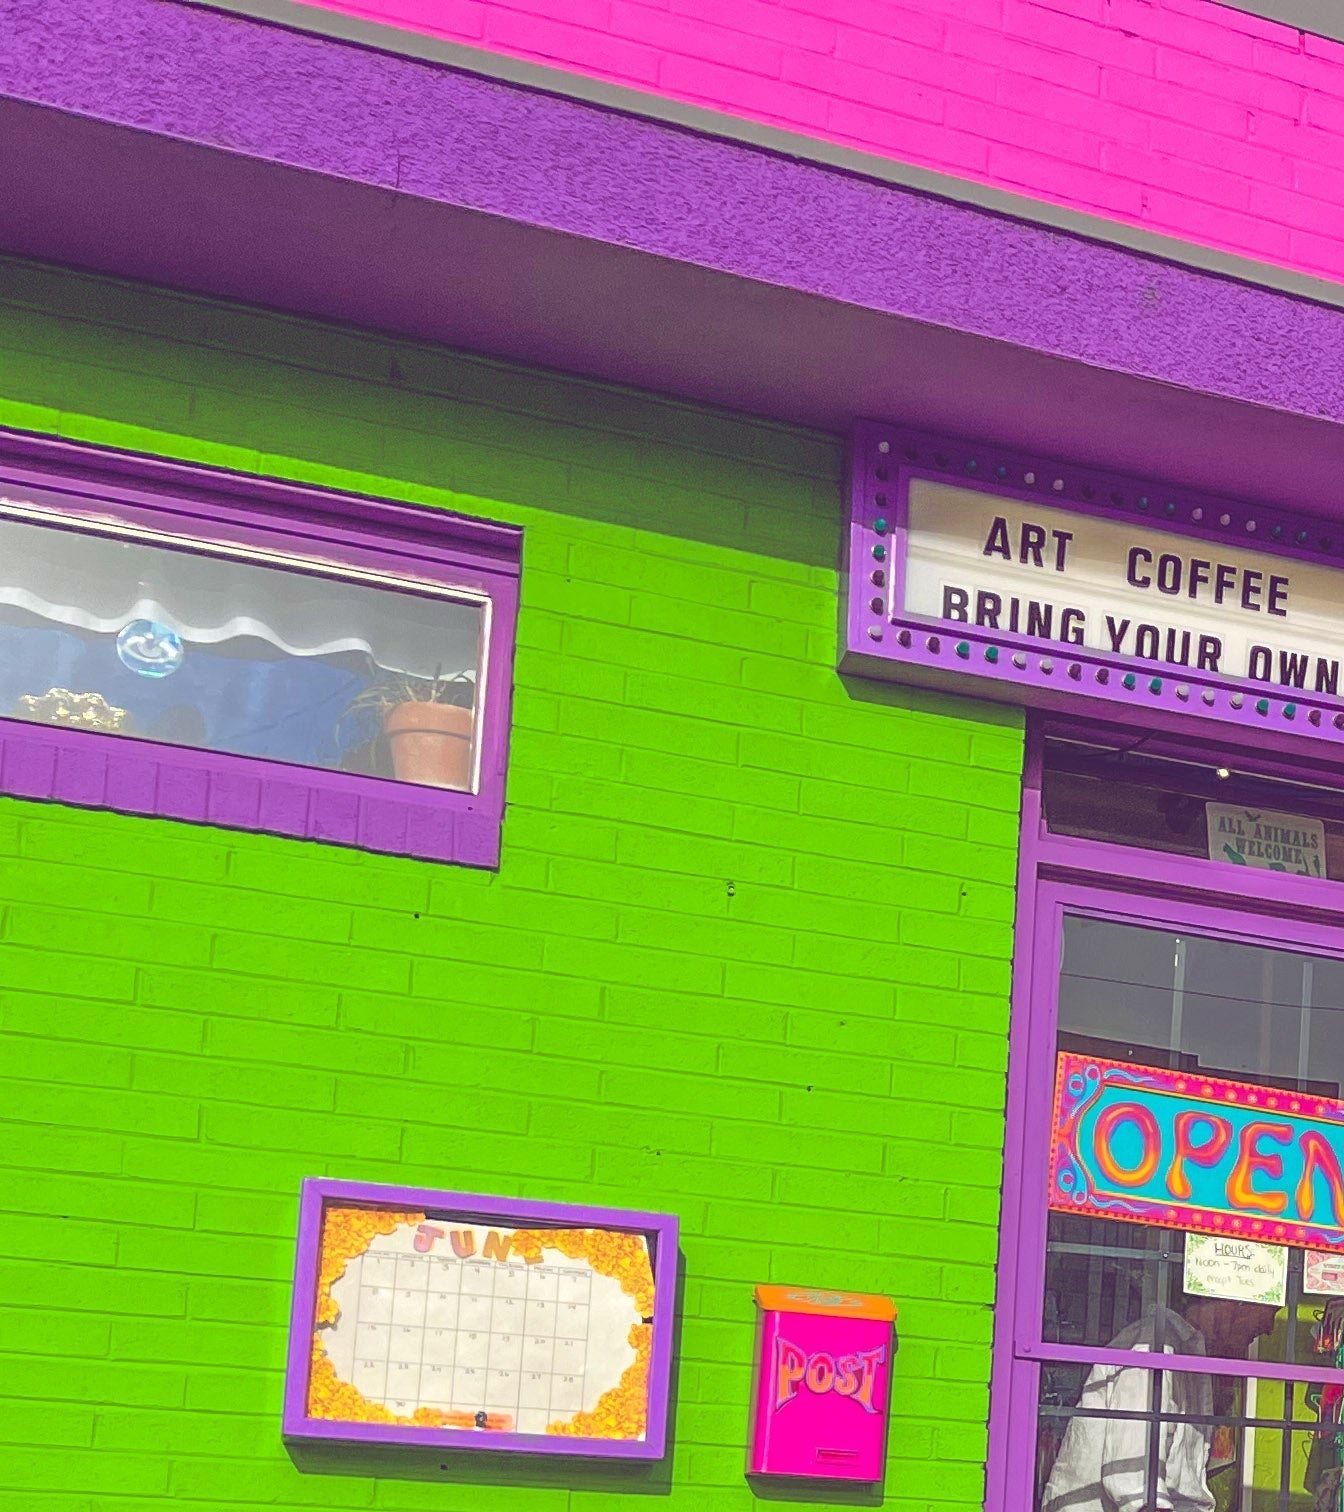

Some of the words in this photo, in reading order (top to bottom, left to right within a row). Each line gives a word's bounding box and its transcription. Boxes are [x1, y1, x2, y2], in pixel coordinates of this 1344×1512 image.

[983, 517, 1073, 572] ART
[1127, 546, 1290, 617] COFFEE
[942, 585, 1086, 648] BRING
[1106, 615, 1223, 674] YOUR
[1248, 645, 1340, 696] OWN
[1218, 815, 1245, 836] ALL
[1253, 822, 1319, 850] ANIMALS
[1235, 836, 1304, 865] WELCOME
[413, 1224, 544, 1265] JUN
[776, 1336, 887, 1414] POST
